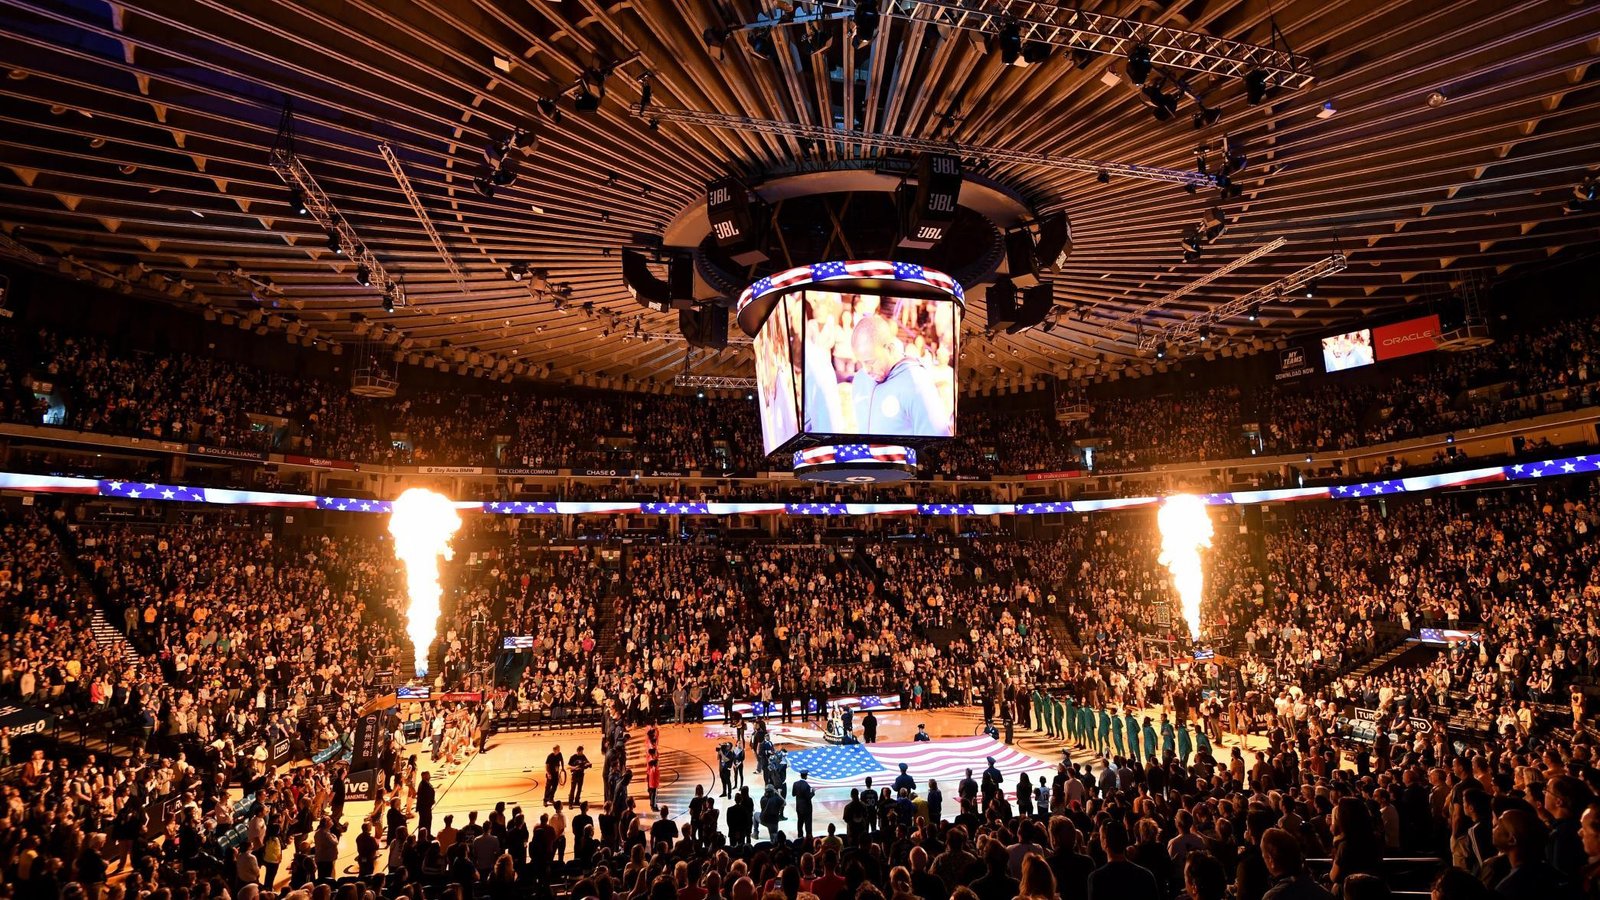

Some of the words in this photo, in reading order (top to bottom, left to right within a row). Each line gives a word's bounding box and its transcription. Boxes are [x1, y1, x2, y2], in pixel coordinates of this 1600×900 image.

[933, 157, 959, 175] JBL
[710, 187, 730, 206] JBL
[928, 193, 954, 212] JBL
[714, 220, 739, 239] JBL
[917, 226, 942, 240] JBL
[1382, 330, 1432, 346] ORACLE
[1283, 356, 1303, 365] TEAMS
[1275, 371, 1301, 380] DOWNLOAD
[228, 449, 262, 459] ALLIANCE
[309, 458, 331, 466] Rakuten
[1358, 711, 1375, 720] TUR
[8, 722, 37, 738] HASE
[276, 742, 288, 755] TURO
